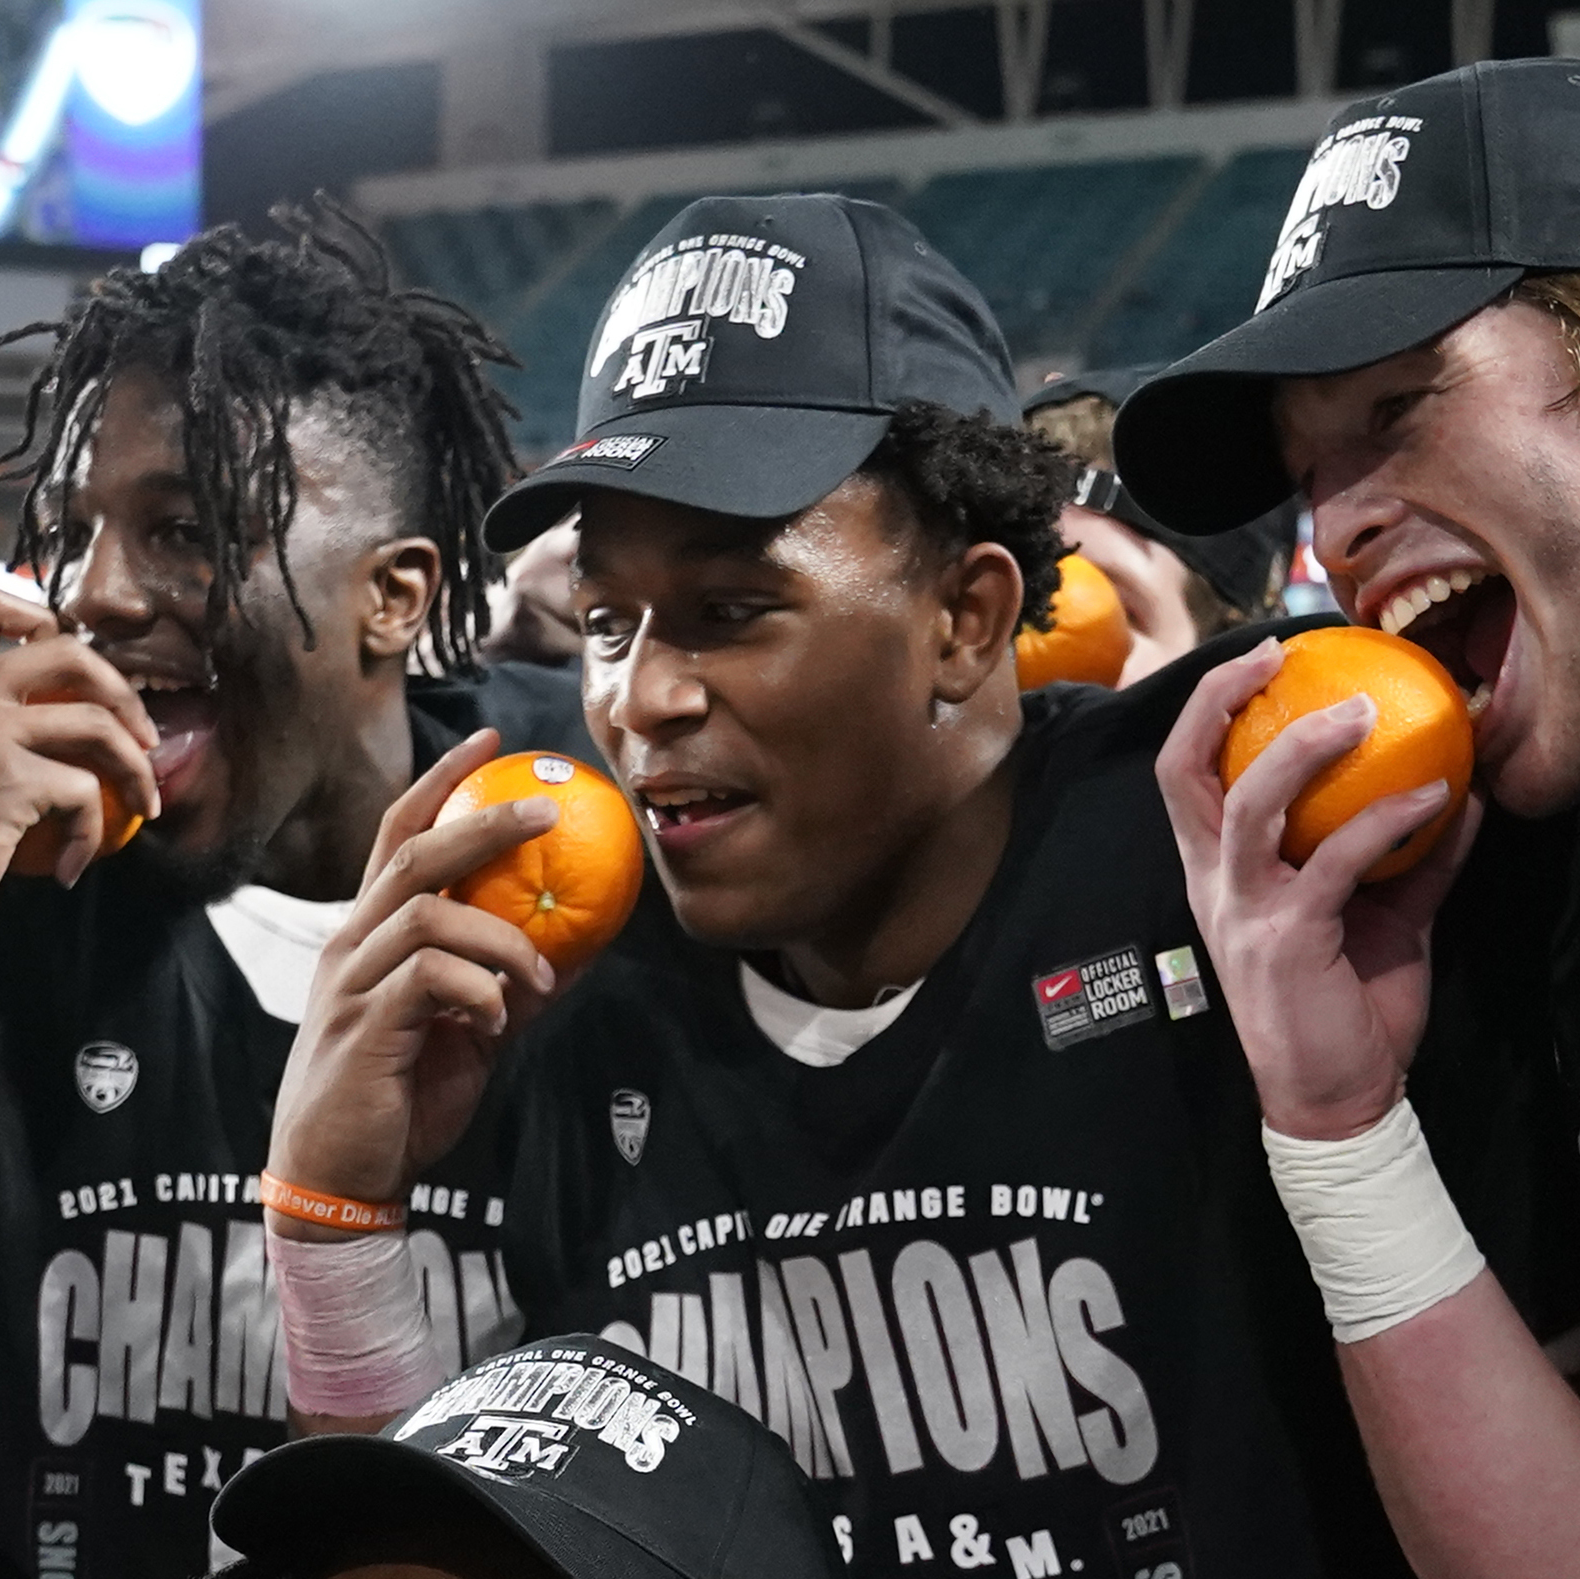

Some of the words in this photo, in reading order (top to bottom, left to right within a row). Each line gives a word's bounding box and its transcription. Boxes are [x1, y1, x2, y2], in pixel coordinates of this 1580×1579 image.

[1080, 951, 1138, 983] OFFICIAL
[1085, 967, 1143, 1002] LOCKER
[1090, 985, 1148, 1021] ROOM
[58, 1177, 138, 1220] 2021
[278, 1185, 338, 1219] Never
[607, 1235, 677, 1289] 2021
[764, 1213, 830, 1240] ONE
[834, 1185, 966, 1232] RANGE
[551, 1349, 588, 1362] ONE
[591, 1355, 658, 1391] ORANGE
[656, 1389, 699, 1428] BOWL
[1122, 1508, 1170, 1542] 2021
